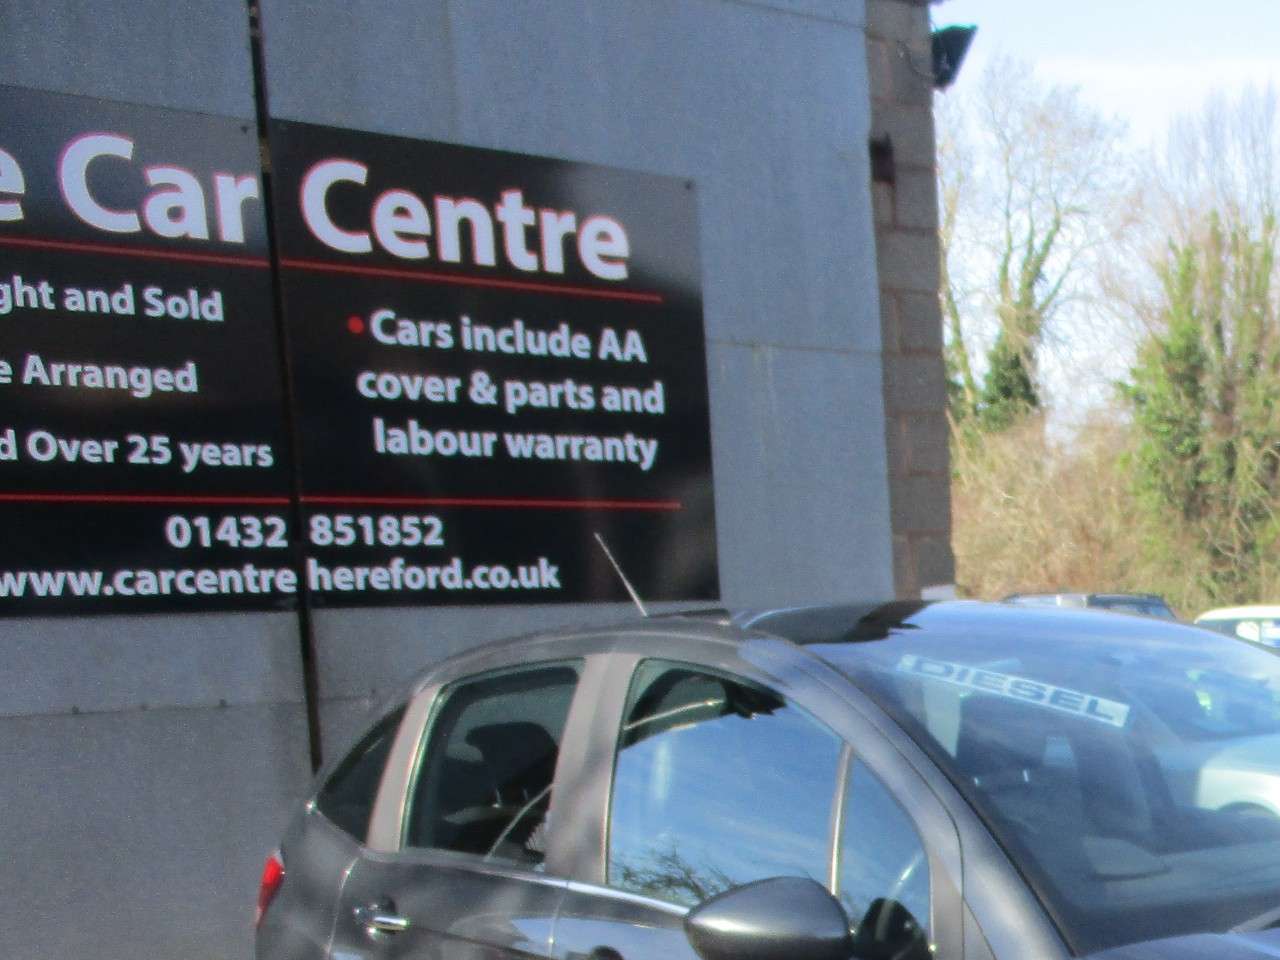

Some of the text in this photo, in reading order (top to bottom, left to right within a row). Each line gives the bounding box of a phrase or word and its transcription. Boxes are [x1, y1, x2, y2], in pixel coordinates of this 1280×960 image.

[58, 132, 259, 244] Car
[301, 158, 630, 281] Centre
[63, 284, 136, 316] and
[142, 285, 225, 322] Sold
[370, 309, 649, 363] Cars include AA
[22, 354, 199, 399] Arranged
[356, 369, 666, 415] cover & parts and
[26, 430, 119, 463] Over
[125, 434, 173, 465] 25
[180, 442, 275, 474] years
[372, 416, 659, 472] labour warranty
[165, 514, 445, 549] 01432 851852
[913, 657, 1115, 721] DIESEL
